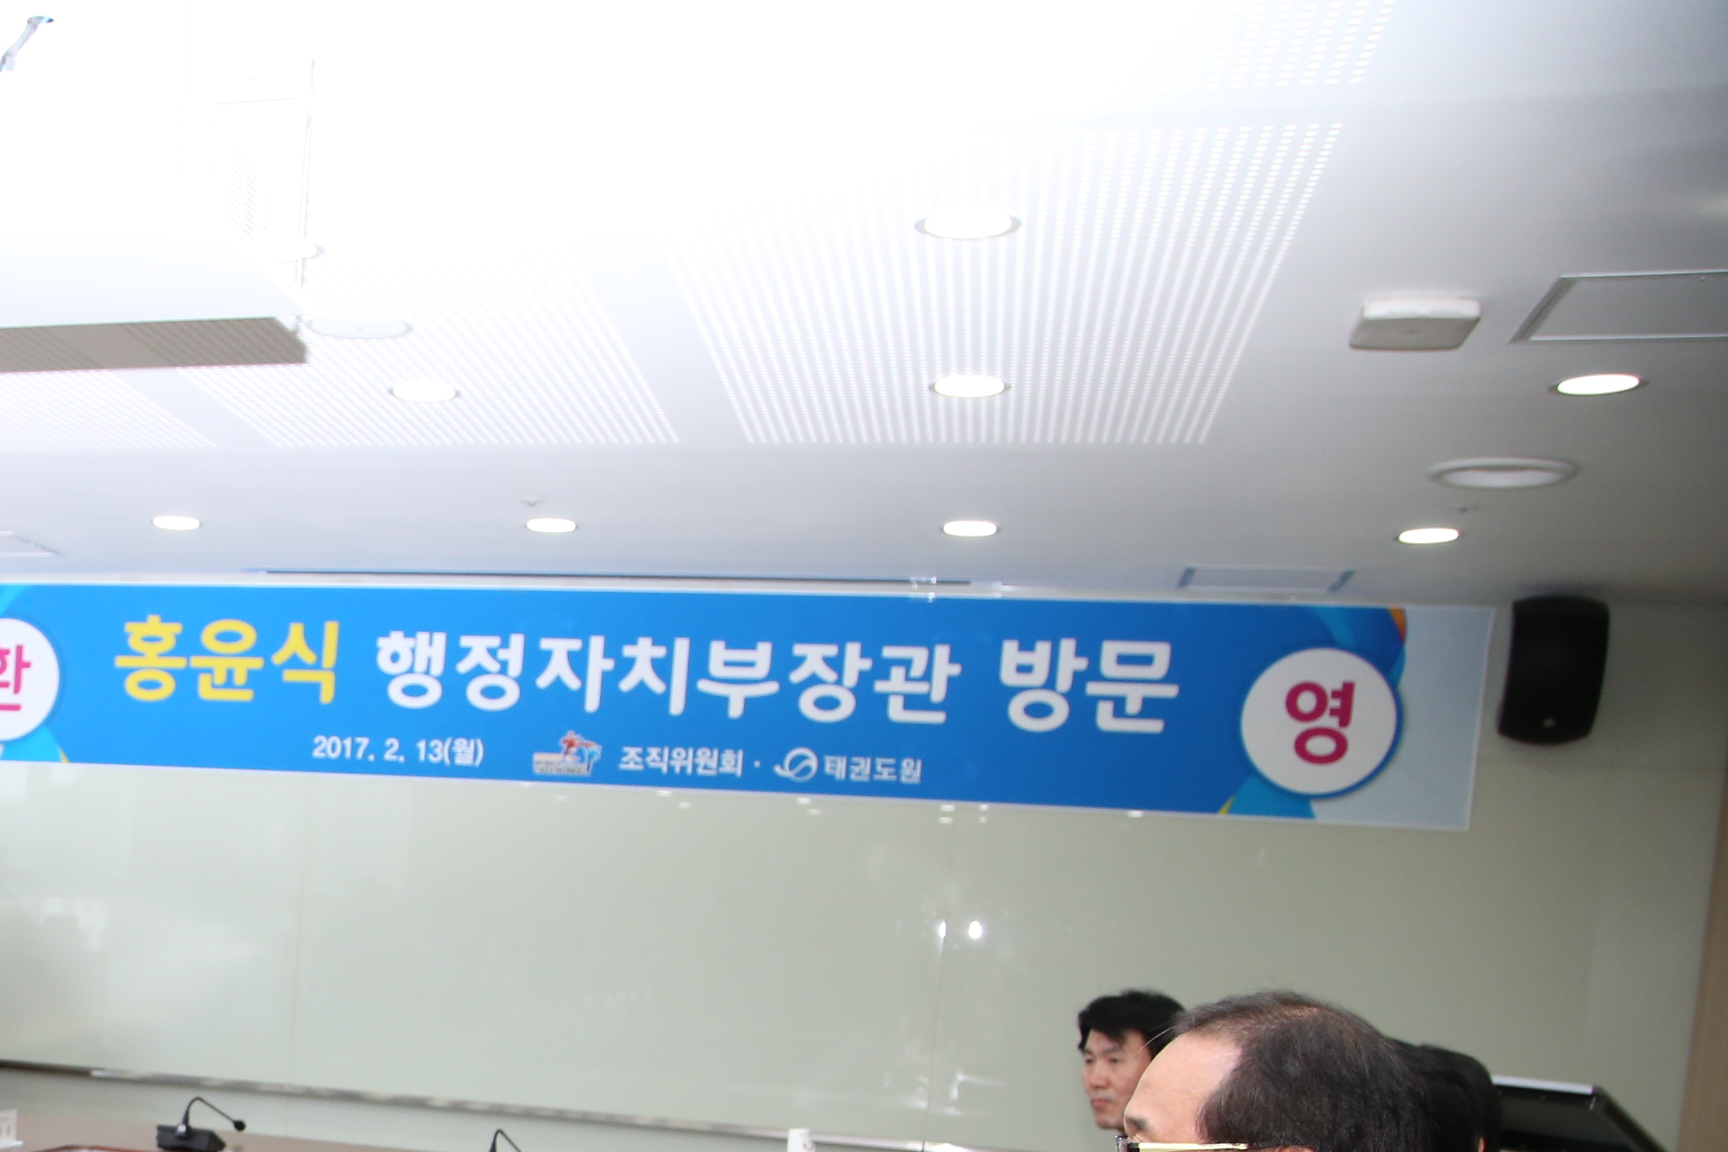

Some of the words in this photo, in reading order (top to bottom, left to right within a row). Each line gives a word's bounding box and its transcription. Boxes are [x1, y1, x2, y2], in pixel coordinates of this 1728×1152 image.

[114, 614, 340, 705] 홍윤식
[376, 630, 962, 725] 행정자치부장관
[999, 637, 1180, 734] 방문
[1285, 680, 1356, 765] 영
[312, 734, 376, 762] 2017.
[384, 737, 406, 763] 2.
[416, 737, 485, 767] 13(월)
[619, 746, 744, 778] 조직위원회
[824, 755, 922, 784] 태권도원
